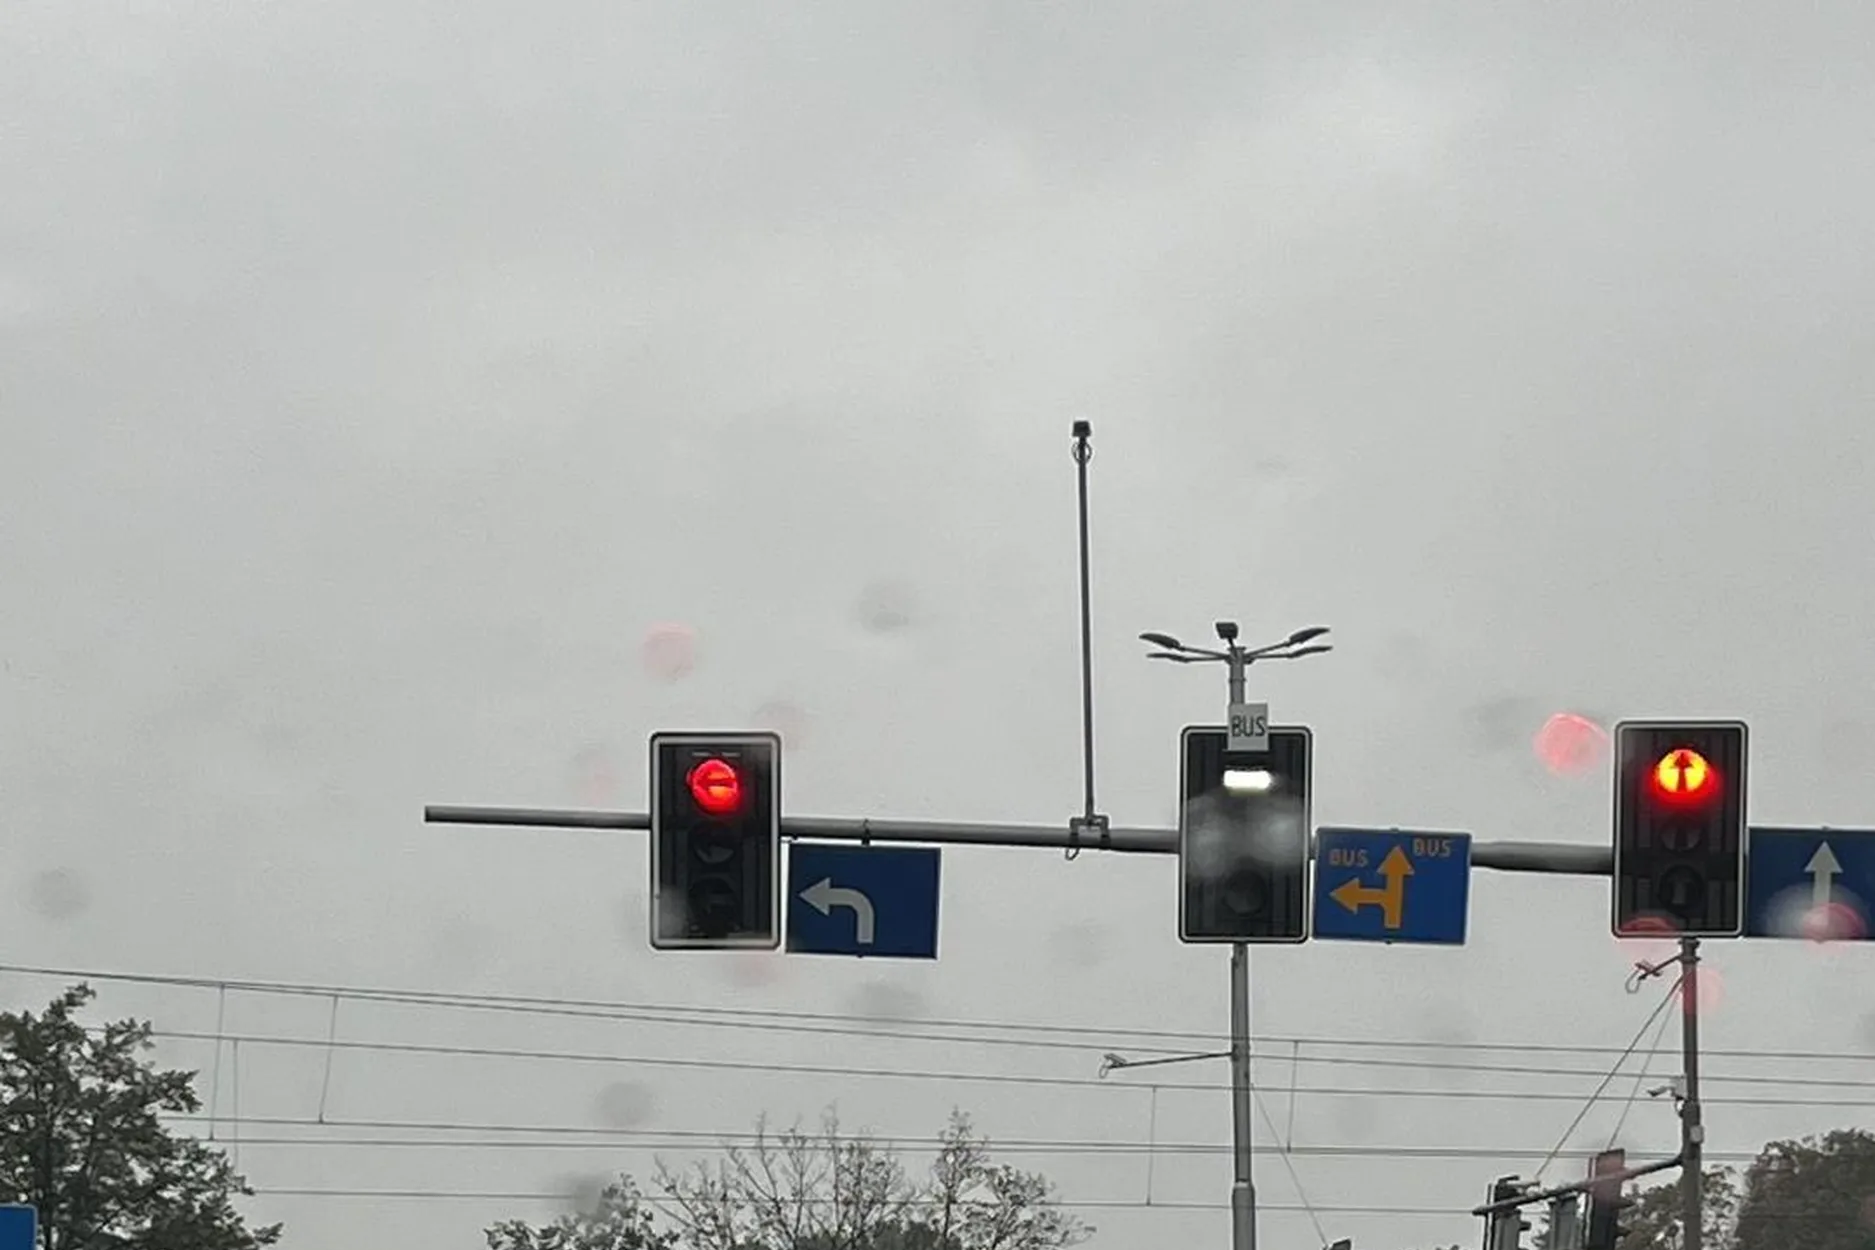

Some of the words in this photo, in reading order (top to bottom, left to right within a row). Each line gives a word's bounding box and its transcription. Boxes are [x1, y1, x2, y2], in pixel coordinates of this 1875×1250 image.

[1231, 716, 1266, 737] BUS
[1413, 838, 1451, 857] BUS
[1329, 849, 1368, 867] BUS
